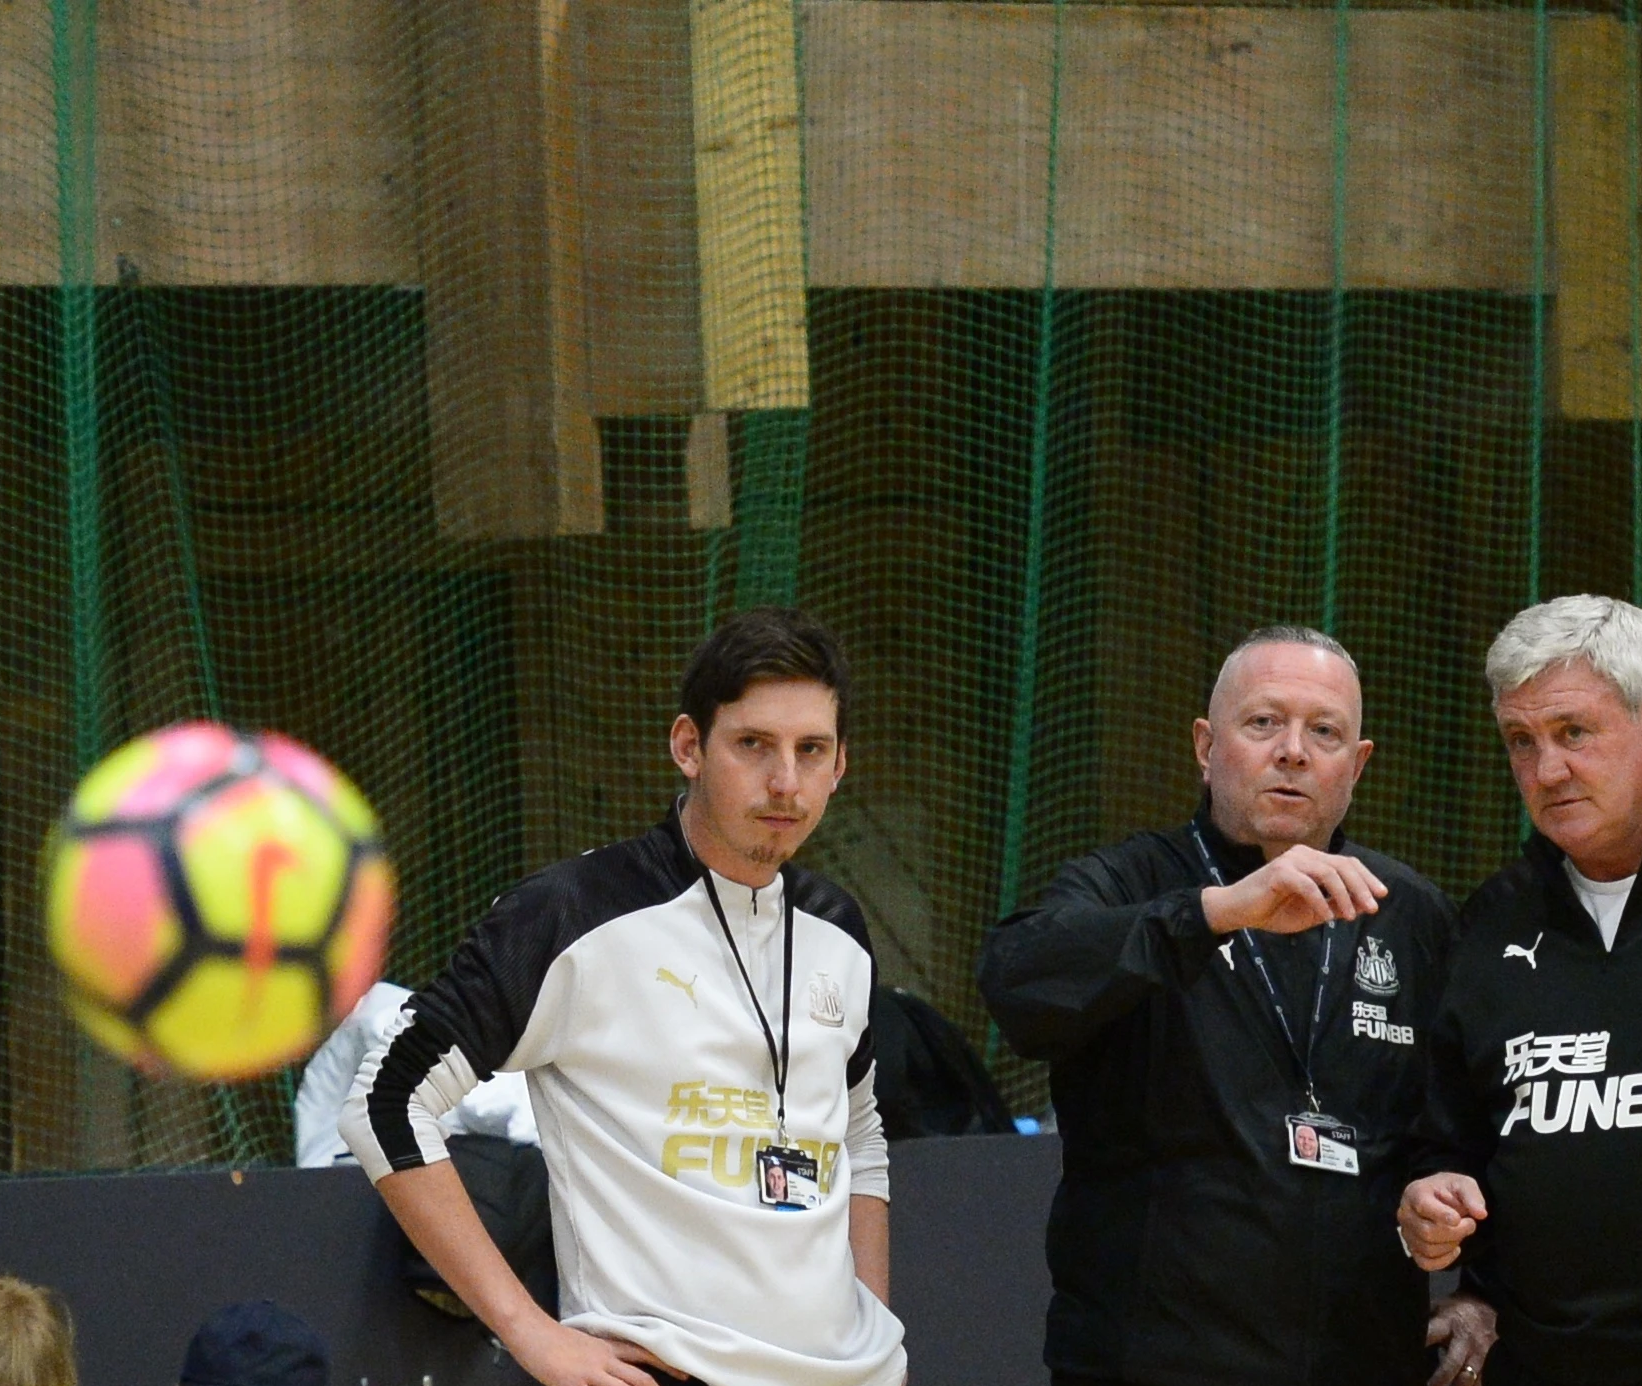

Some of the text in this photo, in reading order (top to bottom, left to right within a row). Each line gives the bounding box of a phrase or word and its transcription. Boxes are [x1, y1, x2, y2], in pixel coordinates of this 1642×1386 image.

[1352, 1019, 1414, 1045] FUN88
[1503, 1030, 1611, 1085] 乐天堂
[664, 1080, 778, 1130] 乐天堂
[661, 1133, 841, 1194] FU8
